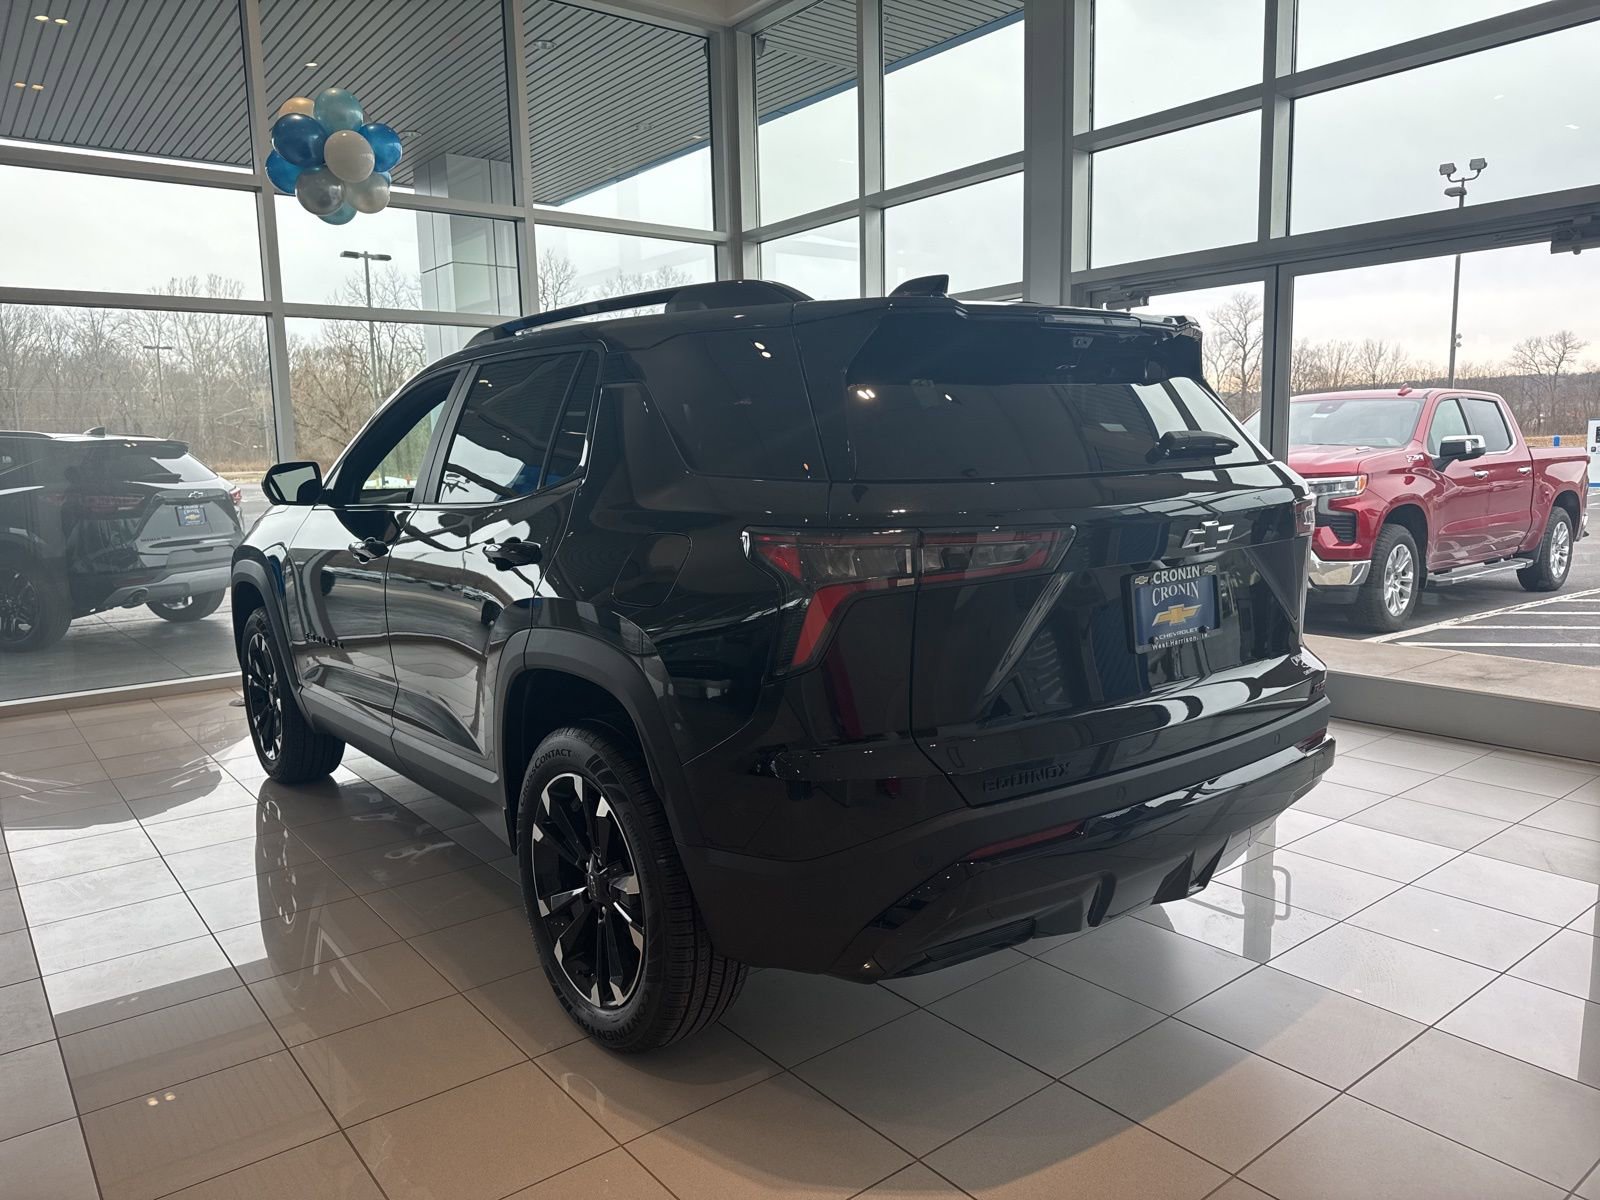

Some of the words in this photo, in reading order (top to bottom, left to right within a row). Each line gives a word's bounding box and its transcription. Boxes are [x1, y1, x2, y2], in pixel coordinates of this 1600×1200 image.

[1153, 565, 1200, 584] CRONIN
[1152, 581, 1199, 606] CRONIN
[1159, 626, 1199, 640] CHEVROLET
